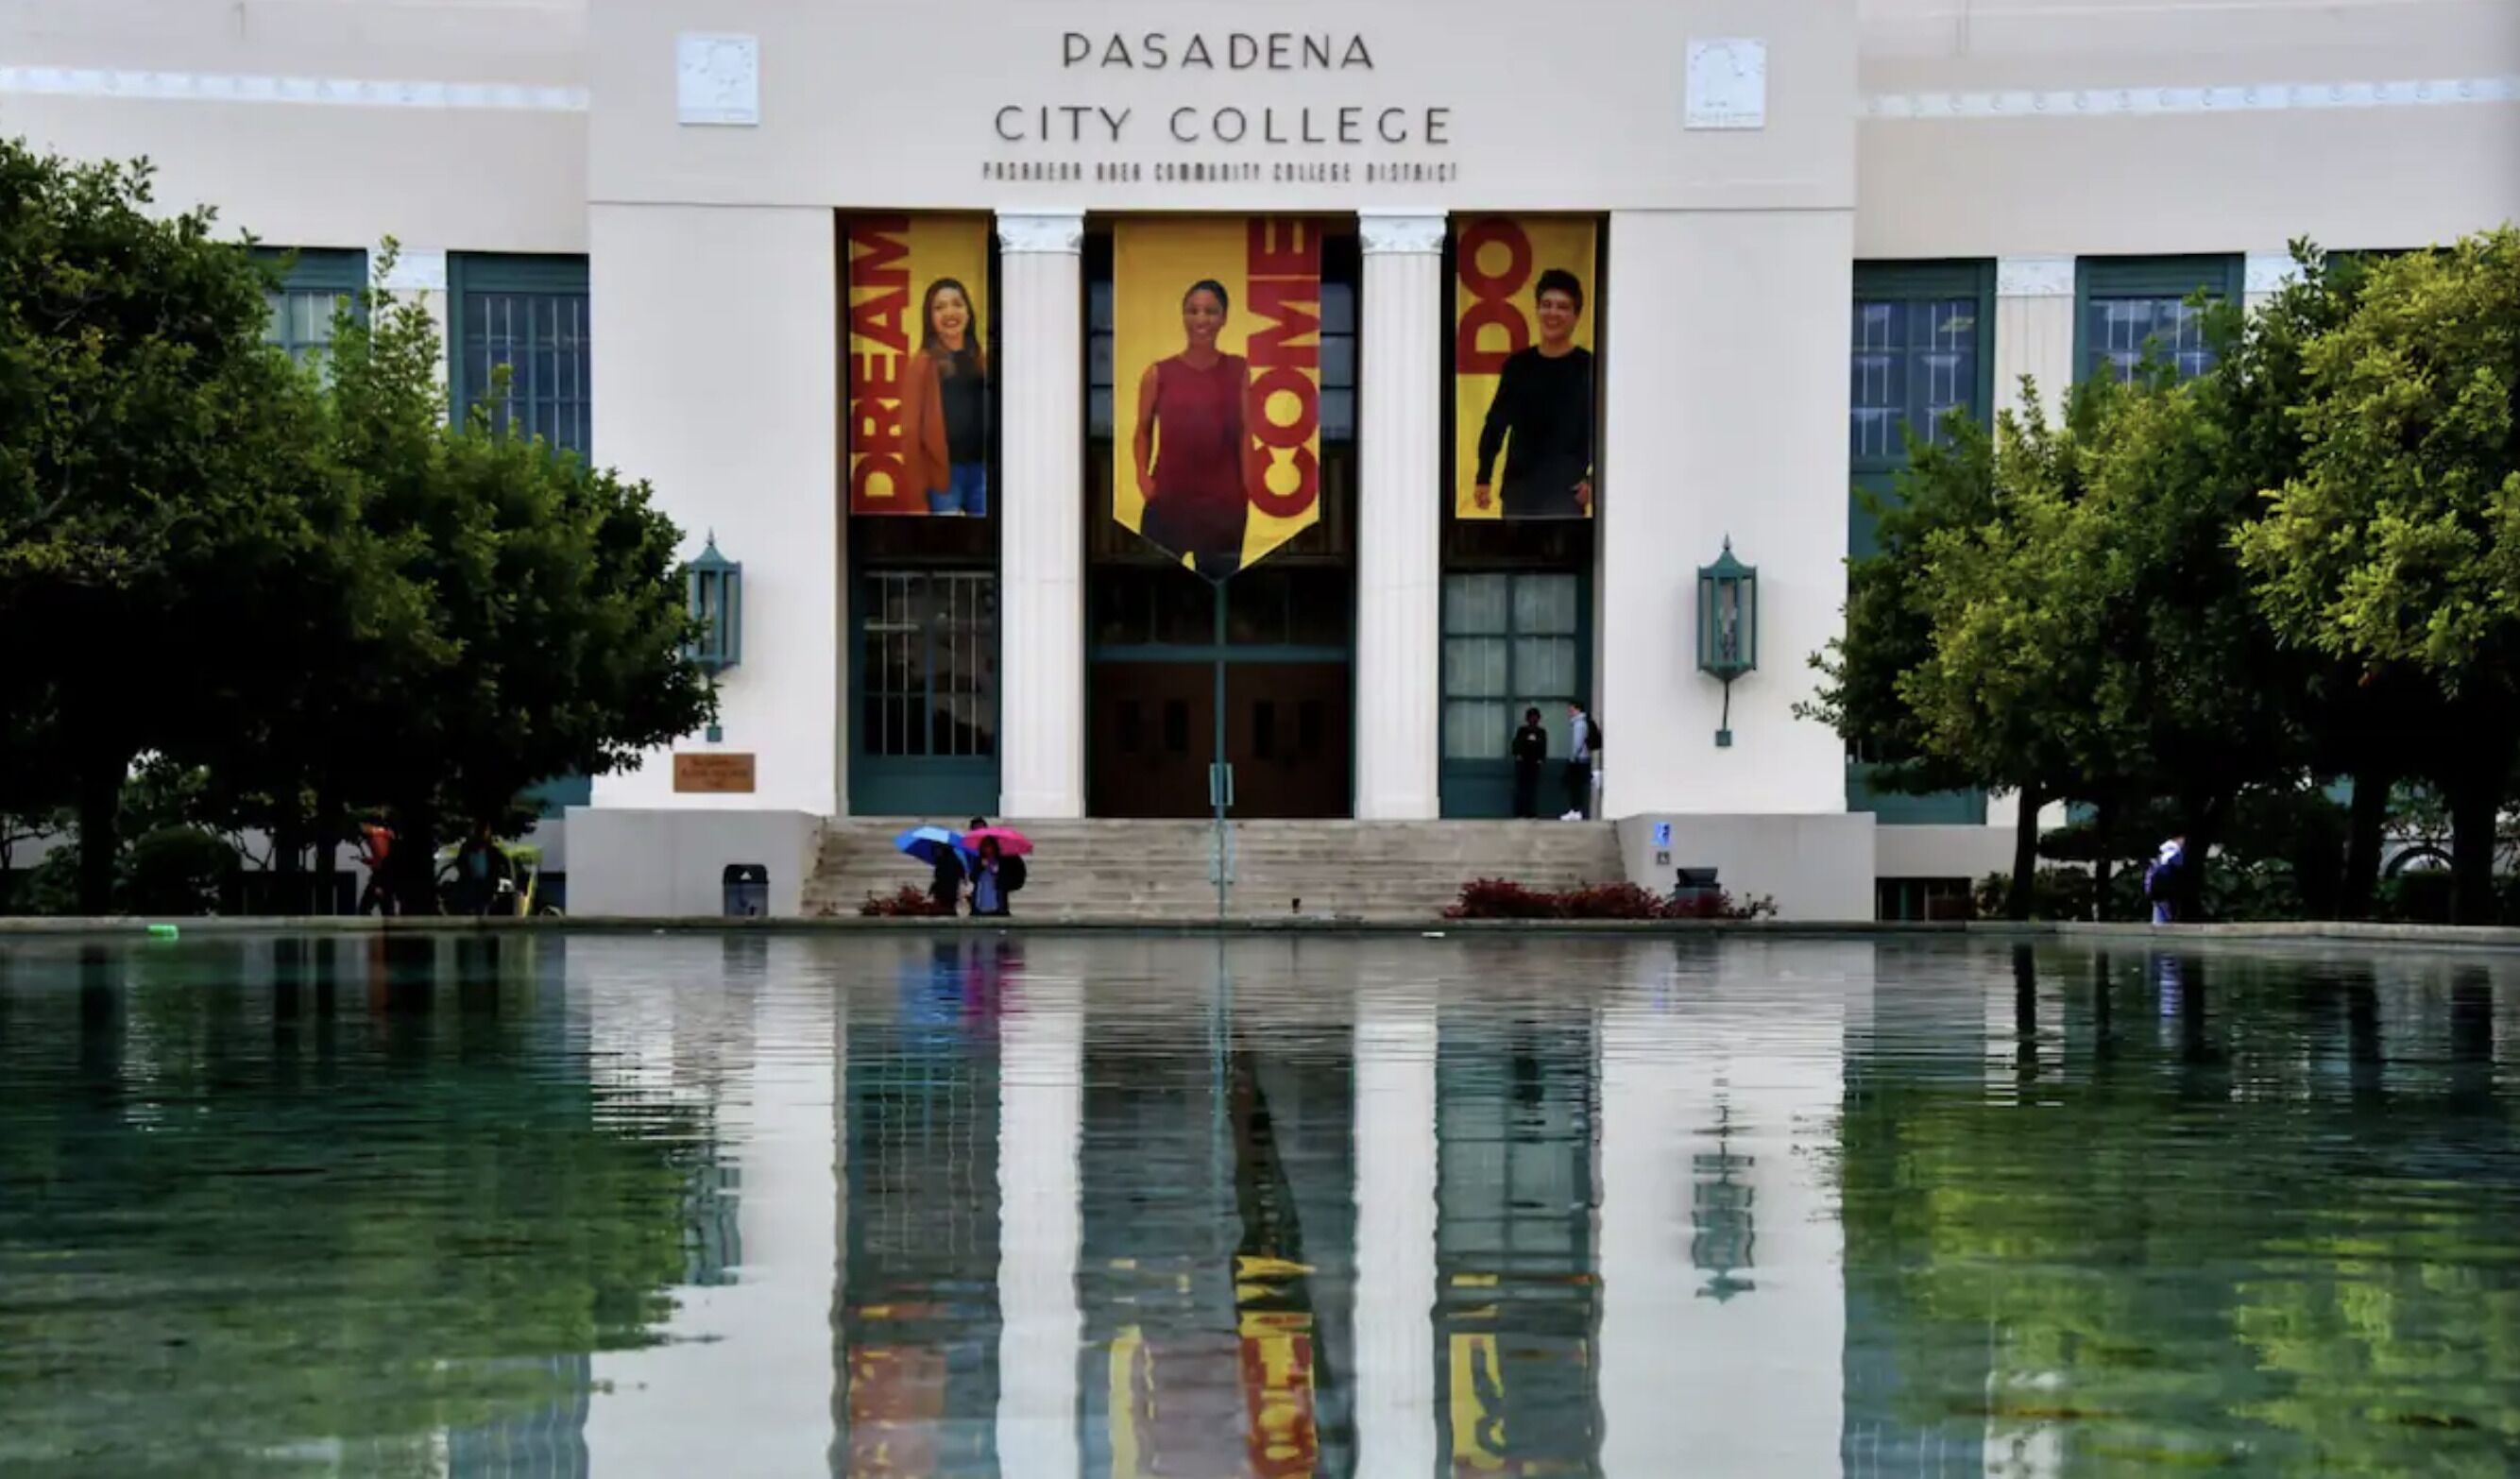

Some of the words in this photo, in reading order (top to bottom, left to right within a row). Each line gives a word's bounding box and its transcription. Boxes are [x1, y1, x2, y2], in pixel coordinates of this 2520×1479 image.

[1064, 33, 1373, 69] PASADENA
[996, 106, 1130, 141] CITY
[1170, 107, 1449, 144] COLLEGE
[1274, 163, 1350, 181] COLLEGE
[1367, 163, 1456, 182] DISTRICT
[1456, 216, 1532, 375] DO
[851, 217, 910, 514] DREAM
[1247, 220, 1320, 518] COME
